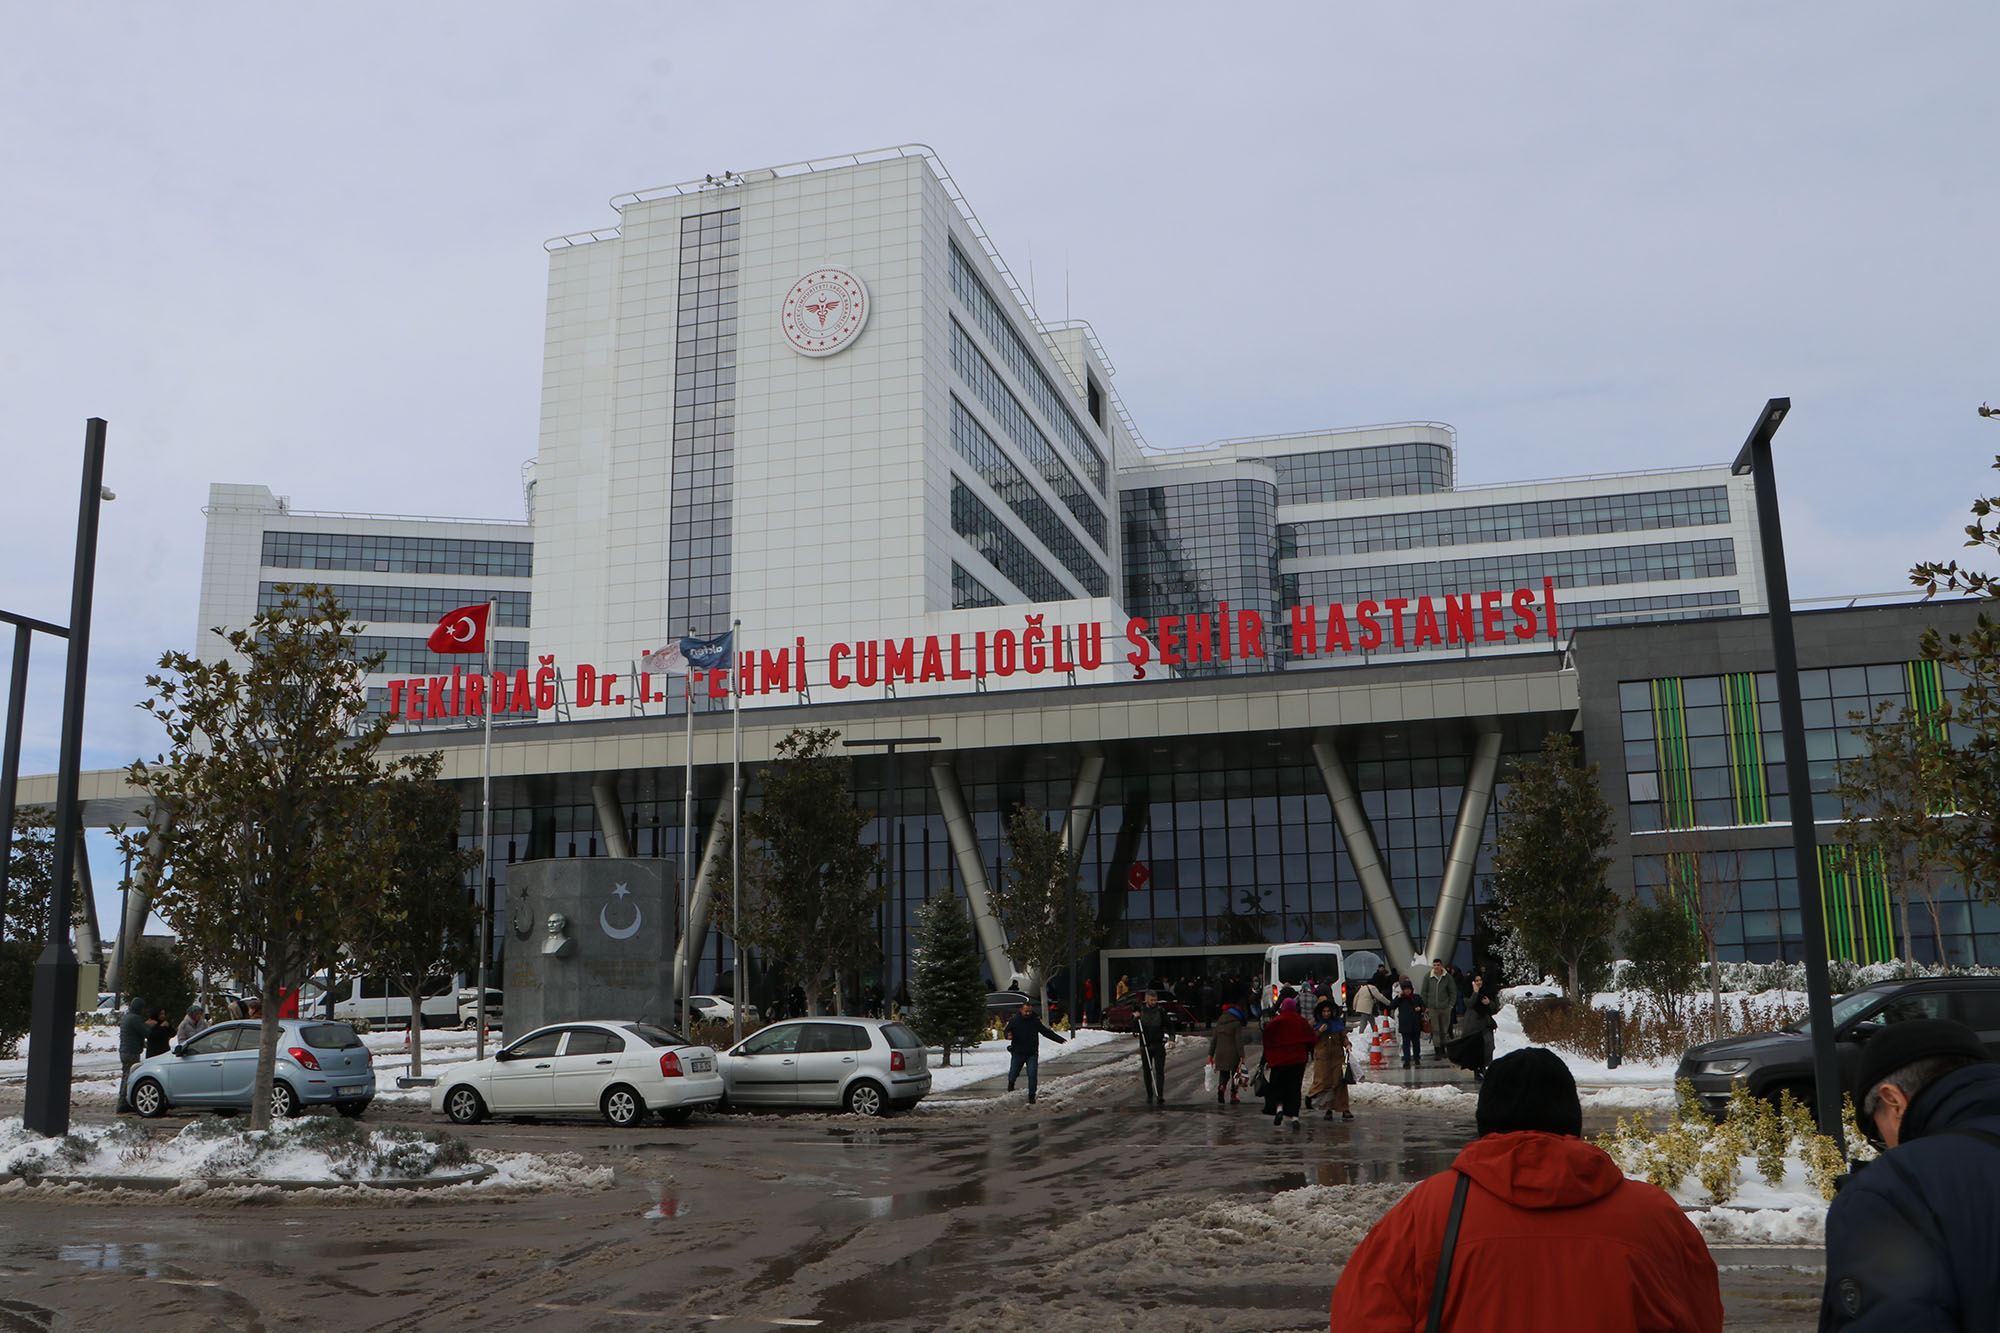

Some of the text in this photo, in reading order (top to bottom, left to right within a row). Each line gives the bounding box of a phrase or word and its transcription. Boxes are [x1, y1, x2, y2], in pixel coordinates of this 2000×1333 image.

[388, 655, 556, 717] TEKİRDAĞ
[576, 664, 624, 709] Dr.
[830, 614, 1102, 690] CUMALIOĞLU
[1127, 602, 1265, 680] ŞEHİR
[1291, 576, 1559, 655] HASTANESİ
